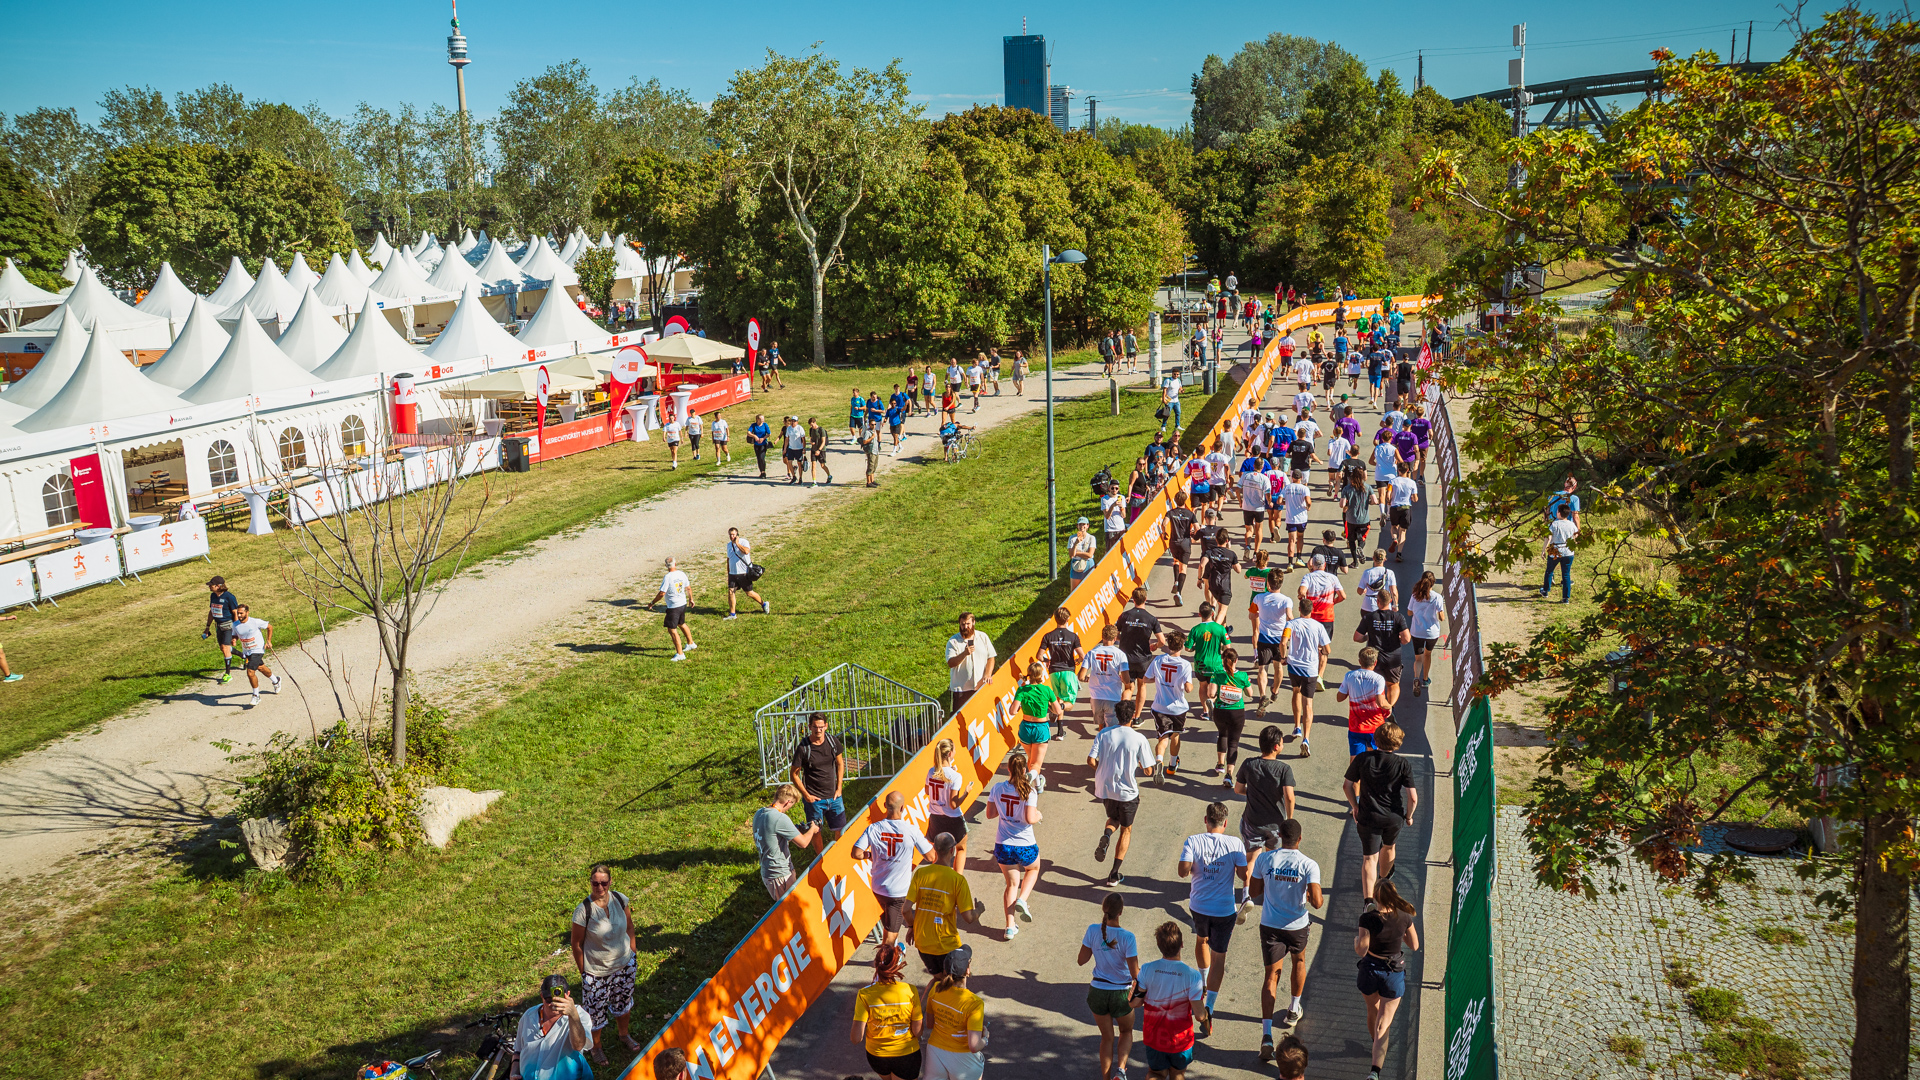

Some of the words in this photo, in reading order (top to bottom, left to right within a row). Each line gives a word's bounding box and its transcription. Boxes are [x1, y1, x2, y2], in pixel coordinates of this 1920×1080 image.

[544, 431, 581, 445] GERECHTIGKEIT
[581, 428, 594, 436] MUSS
[1131, 535, 1150, 565] WIEN
[1075, 599, 1100, 635] WIEN
[1094, 569, 1123, 614] ENERGIE
[1275, 868, 1299, 877] DIGITAL
[1275, 875, 1299, 883] RUNWAY
[709, 931, 812, 1067] ENERGIE
